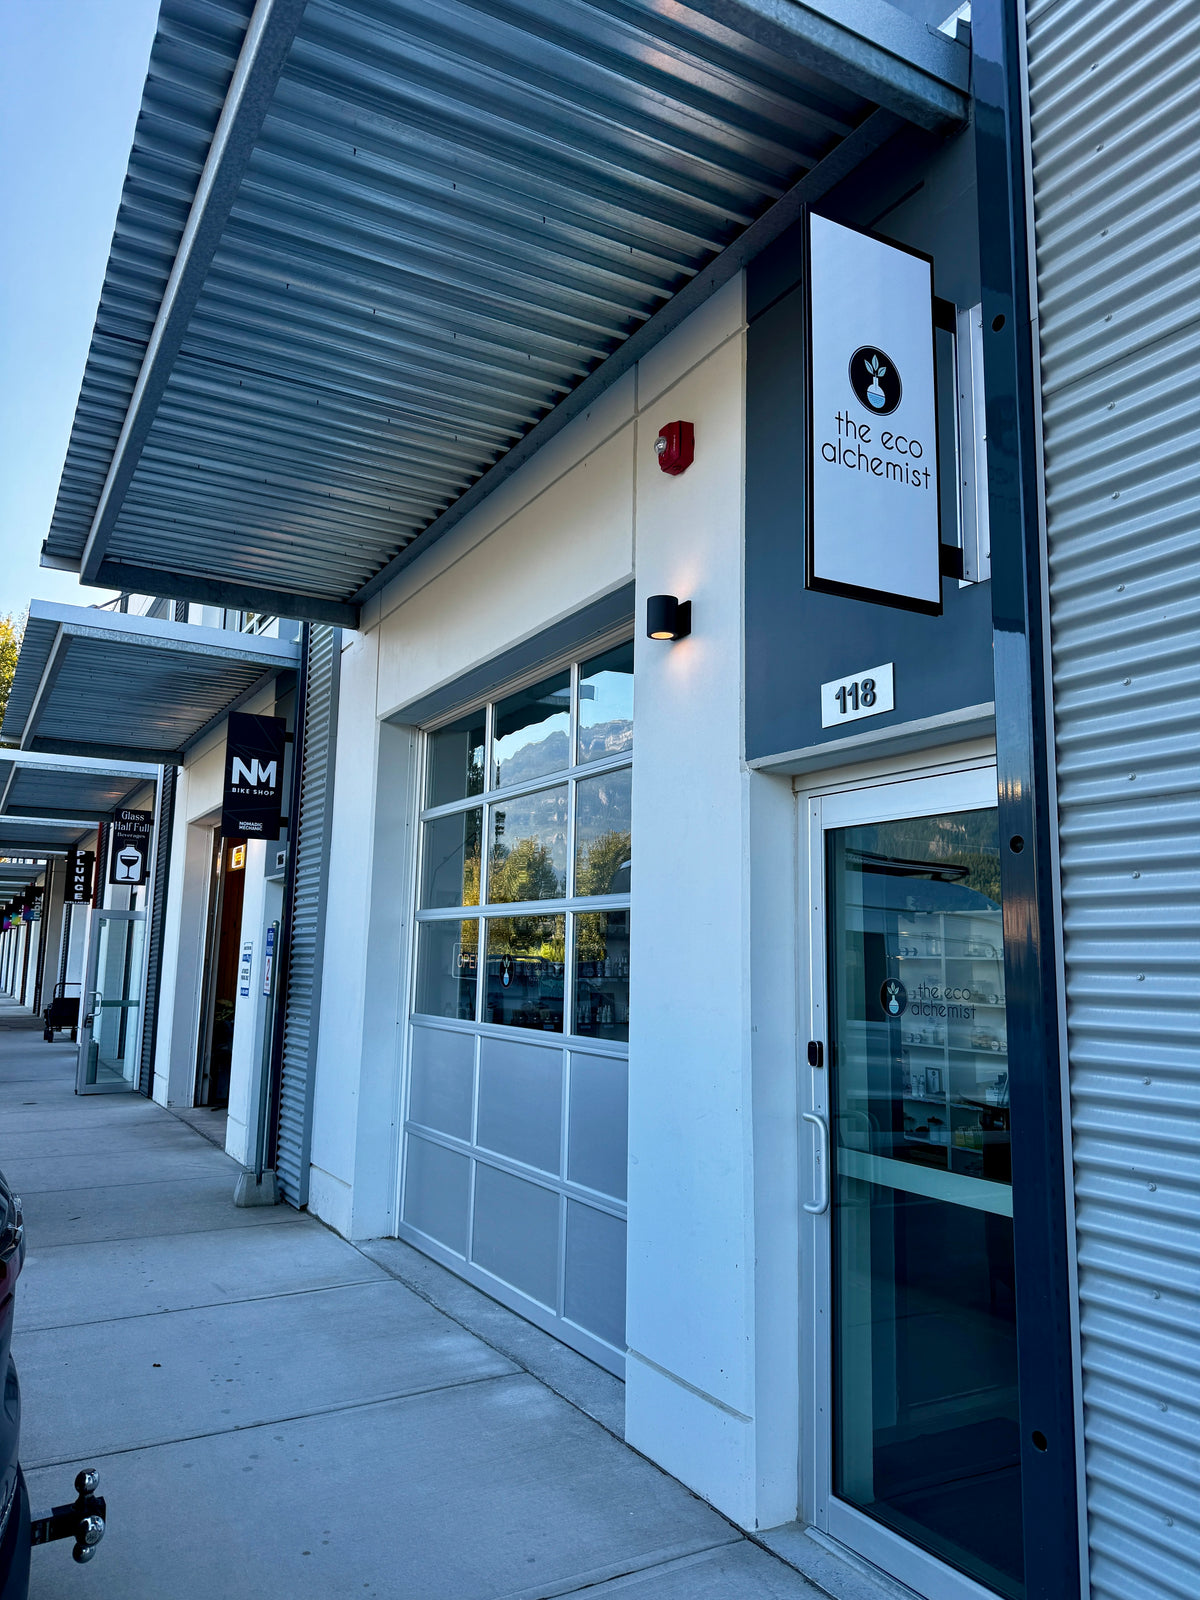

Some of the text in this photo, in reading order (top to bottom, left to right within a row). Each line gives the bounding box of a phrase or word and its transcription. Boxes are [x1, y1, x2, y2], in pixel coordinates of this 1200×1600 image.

[835, 410, 923, 458] the eco
[821, 438, 931, 489] alchemist
[835, 678, 876, 714] 118
[231, 756, 277, 788] NM
[231, 787, 250, 795] BIKE
[115, 821, 150, 833] Half Full
[121, 810, 145, 821] Glass
[74, 850, 86, 900] PLUNGE
[918, 980, 971, 1000] the eco
[911, 1000, 976, 1020] alchemist
